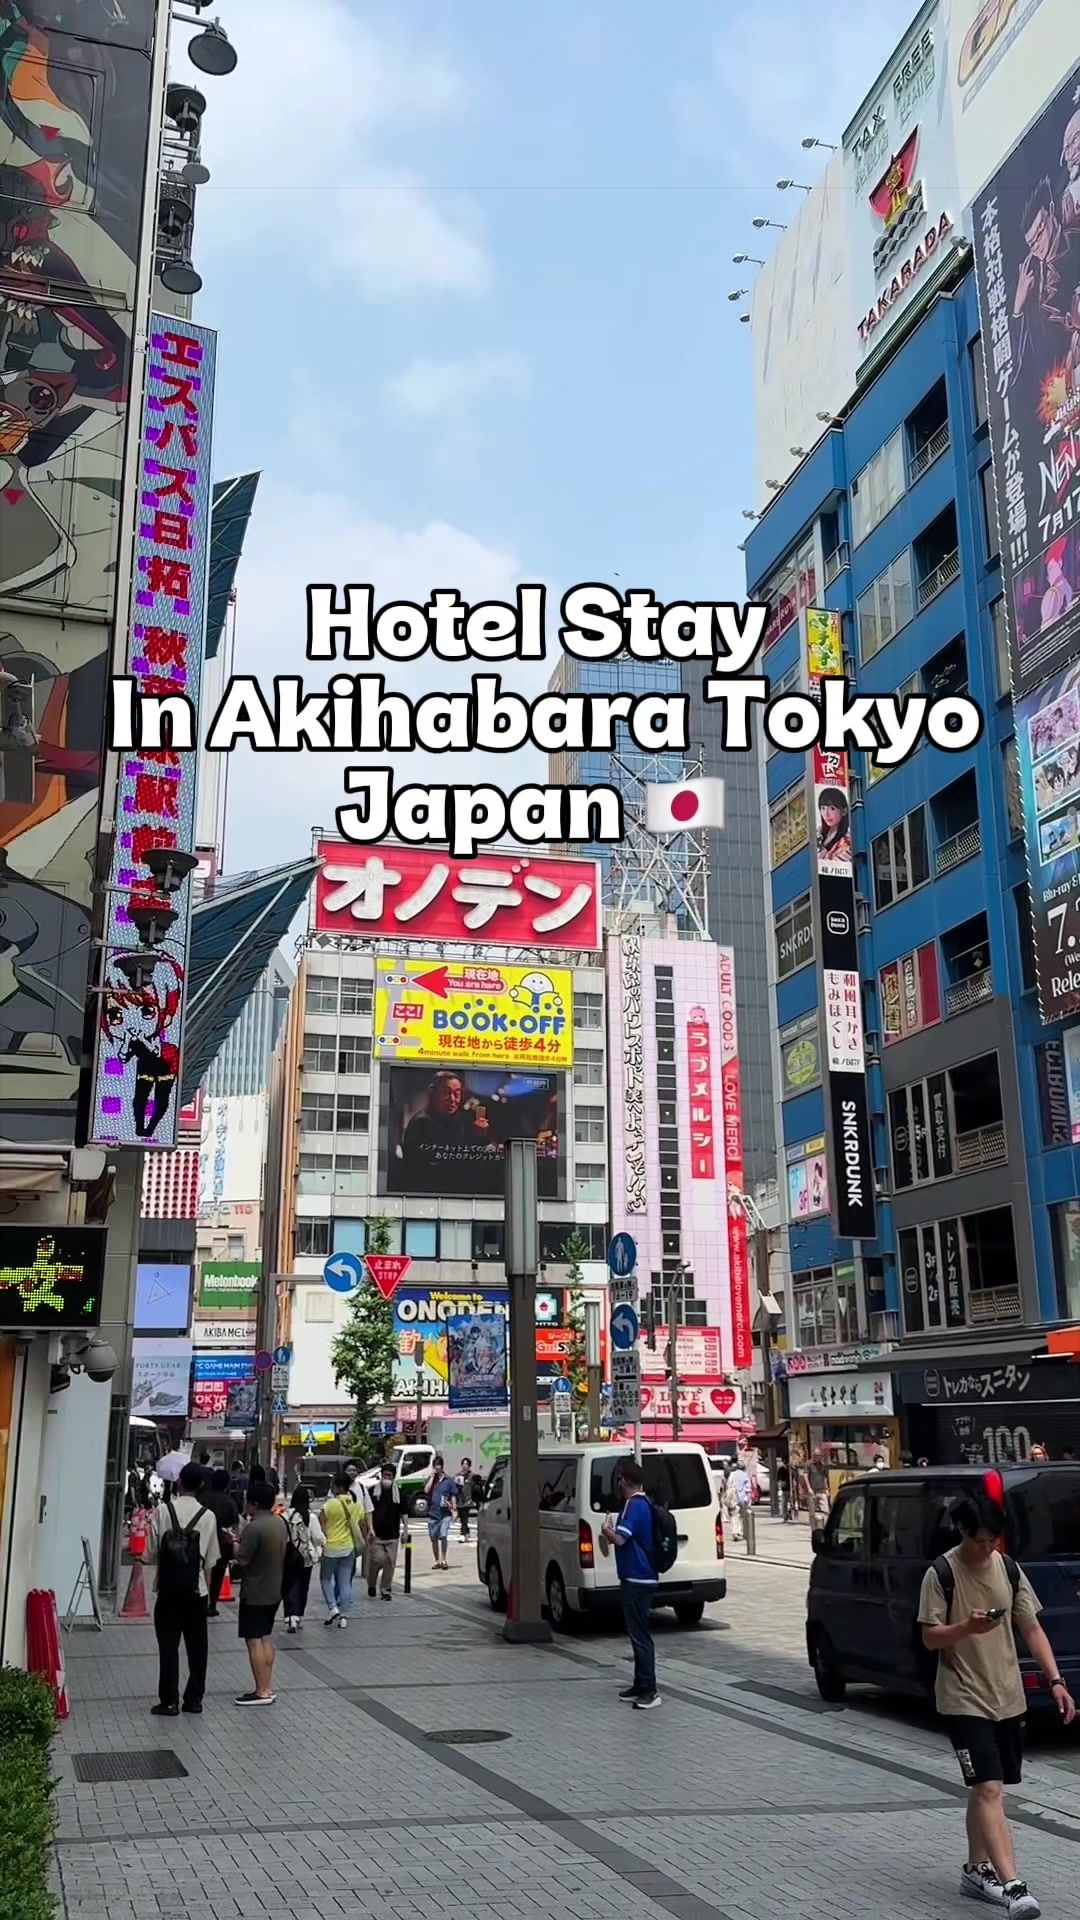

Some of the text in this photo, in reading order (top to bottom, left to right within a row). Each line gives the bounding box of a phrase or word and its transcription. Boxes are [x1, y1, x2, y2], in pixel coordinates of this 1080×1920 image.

[852, 27, 934, 162] TAX FREE
[857, 210, 954, 341] TAKARADA
[146, 331, 199, 600] エスパス日拓
[321, 856, 594, 933] オノデン
[1043, 880, 1072, 903] Blu-ray
[1047, 896, 1080, 955] 7.
[448, 978, 502, 990] You are here
[463, 966, 501, 981] 現在地
[719, 953, 732, 997] ADULT
[438, 1033, 562, 1053] 現在地から徒歩4分
[452, 1049, 469, 1057] walk
[471, 1050, 491, 1059] from
[492, 1051, 510, 1060] here
[689, 1031, 712, 1173] ラブメルシー
[724, 1074, 741, 1161] LOVE MERCI
[841, 1100, 864, 1208] SNKRDUNK
[374, 1259, 402, 1270] 止まれ
[925, 1251, 937, 1269] 3F
[378, 1271, 399, 1281] STOP
[946, 1231, 961, 1316] トレカ販売
[429, 1291, 483, 1301] Welcome to
[731, 1225, 746, 1360] www.akibalovemerci.com
[928, 1284, 939, 1302] 2F
[397, 1299, 510, 1322] ONODEN
[203, 1327, 227, 1338] AKIBA
[391, 1378, 449, 1397] AKIH
[983, 1426, 1031, 1462] 100
